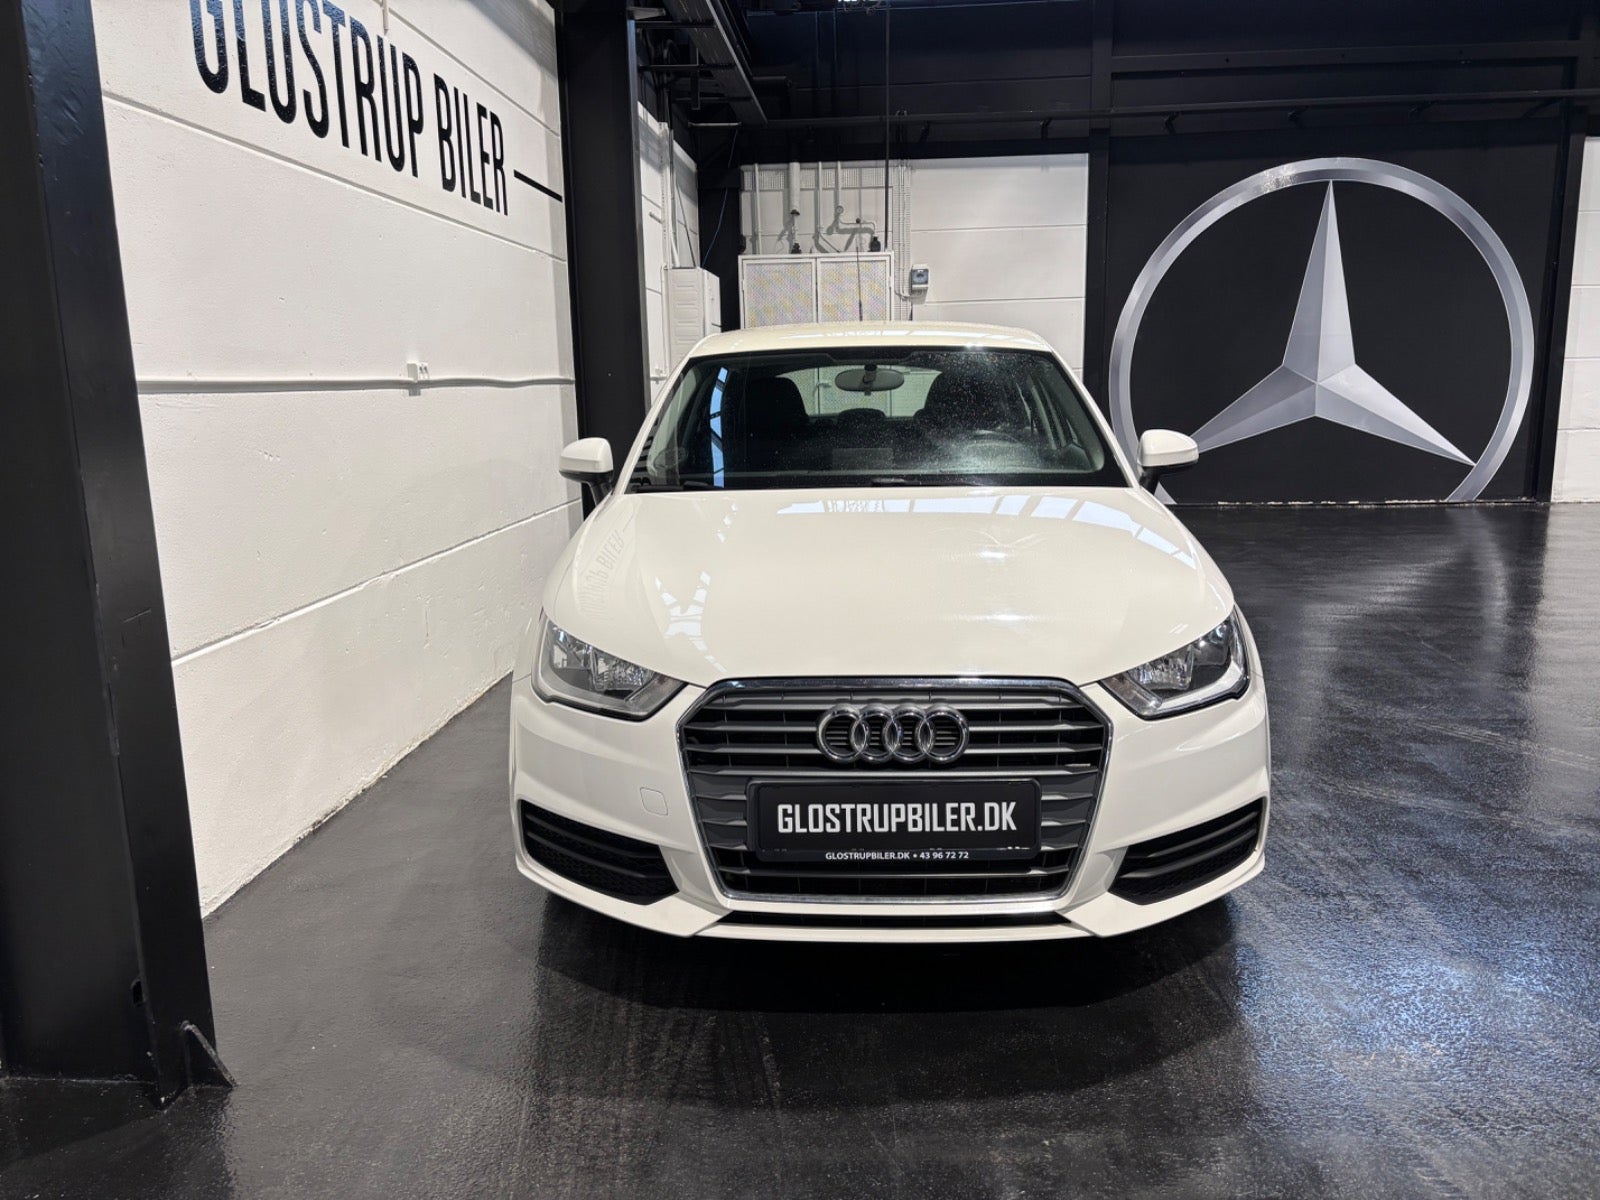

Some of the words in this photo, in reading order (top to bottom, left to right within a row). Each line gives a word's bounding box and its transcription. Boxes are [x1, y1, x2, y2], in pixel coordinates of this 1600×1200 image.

[433, 73, 508, 216] BILER
[777, 801, 1017, 833] GLOSTRUPBILER.DK
[825, 851, 910, 860] GLOSTRUPBILER.DK
[919, 851, 931, 860] 43
[932, 851, 944, 859] 96
[945, 851, 957, 859] 72
[958, 851, 969, 859] 72
